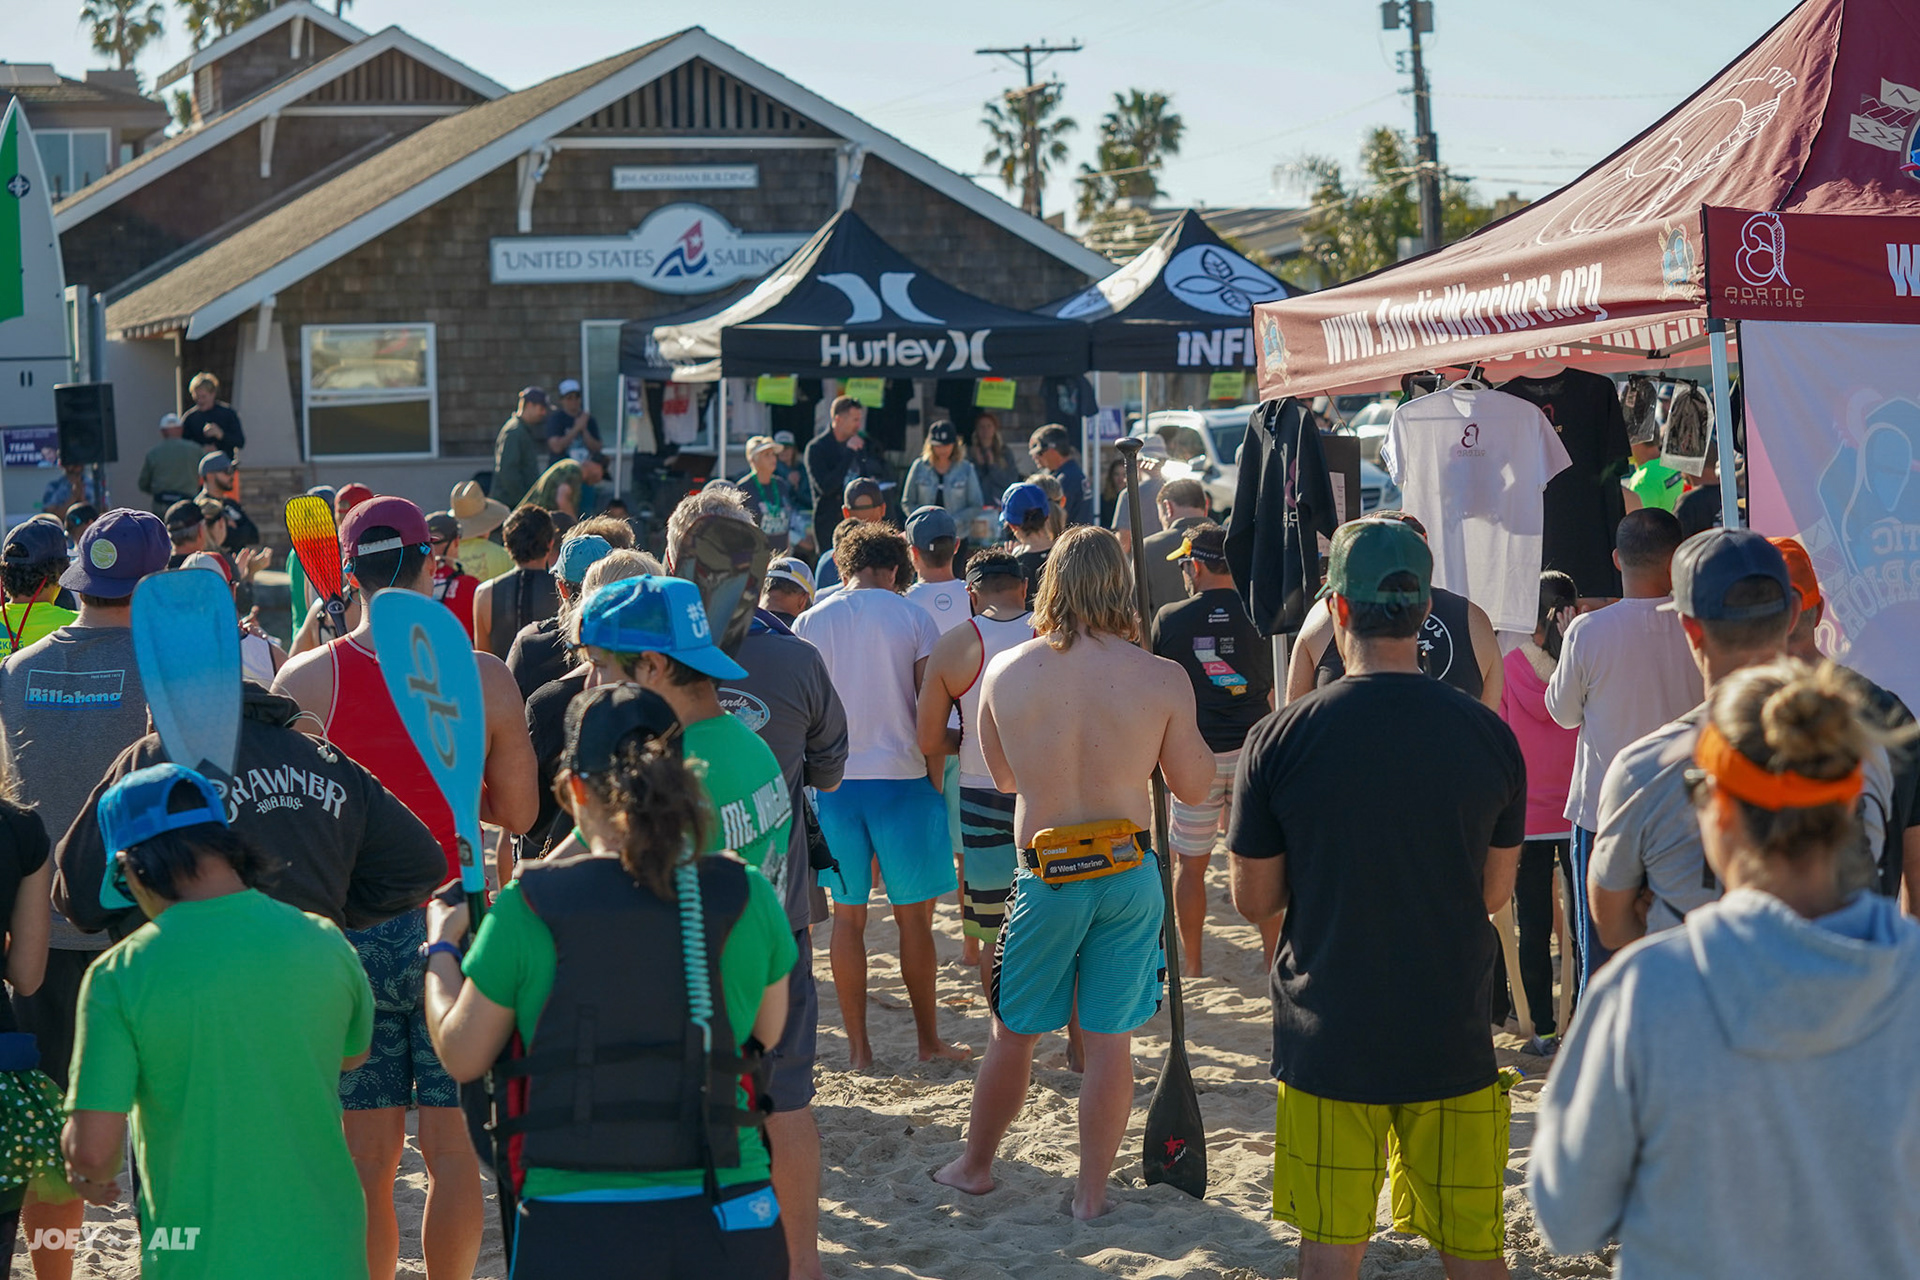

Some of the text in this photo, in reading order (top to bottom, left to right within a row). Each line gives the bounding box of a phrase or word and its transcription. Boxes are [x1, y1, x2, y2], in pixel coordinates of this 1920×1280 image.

[503, 247, 785, 271] UNITED STATES SAILING
[1724, 287, 1805, 300] AORTIC
[1729, 299, 1803, 308] WARRIORS
[820, 332, 947, 371] Hurley
[28, 688, 123, 704] Billabong
[720, 697, 749, 708] ards
[1042, 847, 1067, 856] Coastal
[1058, 860, 1103, 873] West Marine
